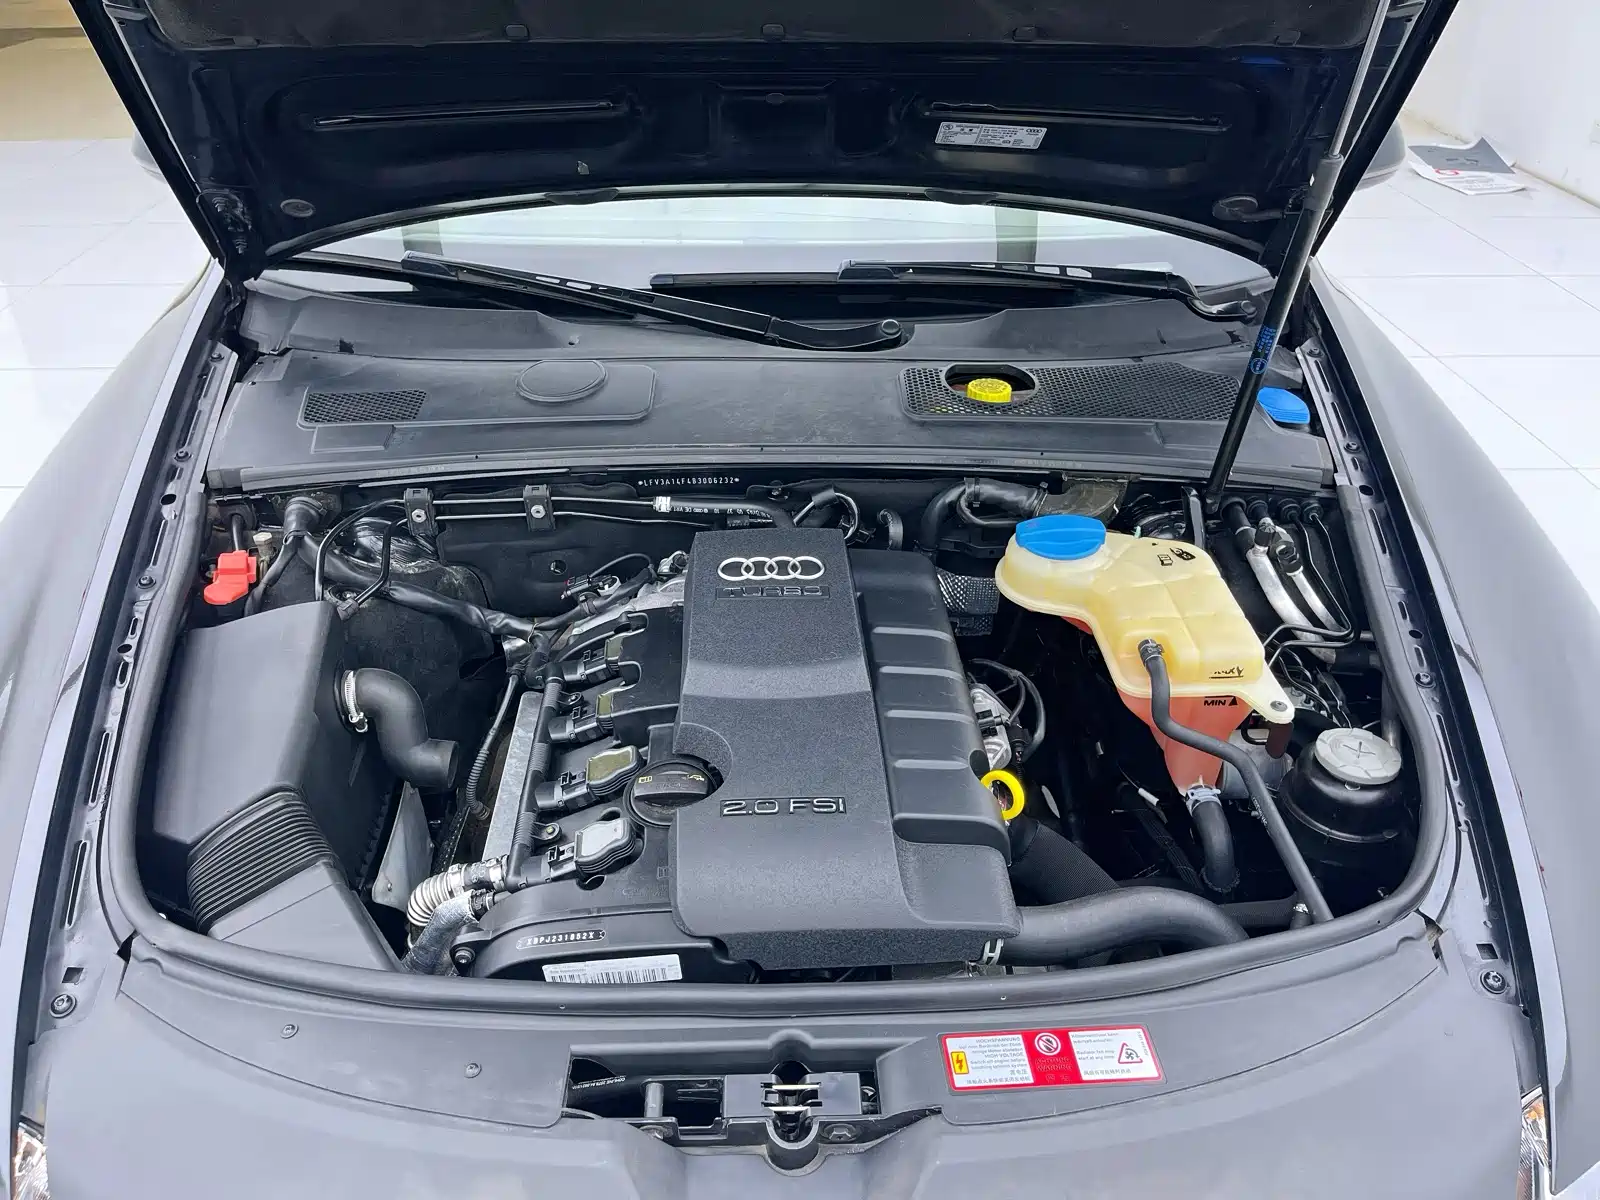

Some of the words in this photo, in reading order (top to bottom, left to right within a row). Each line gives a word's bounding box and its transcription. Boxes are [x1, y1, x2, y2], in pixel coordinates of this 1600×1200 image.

[723, 586, 822, 597] TURBO
[1203, 699, 1227, 707] MIN
[723, 800, 779, 815] 2.0
[789, 798, 844, 814] FSI
